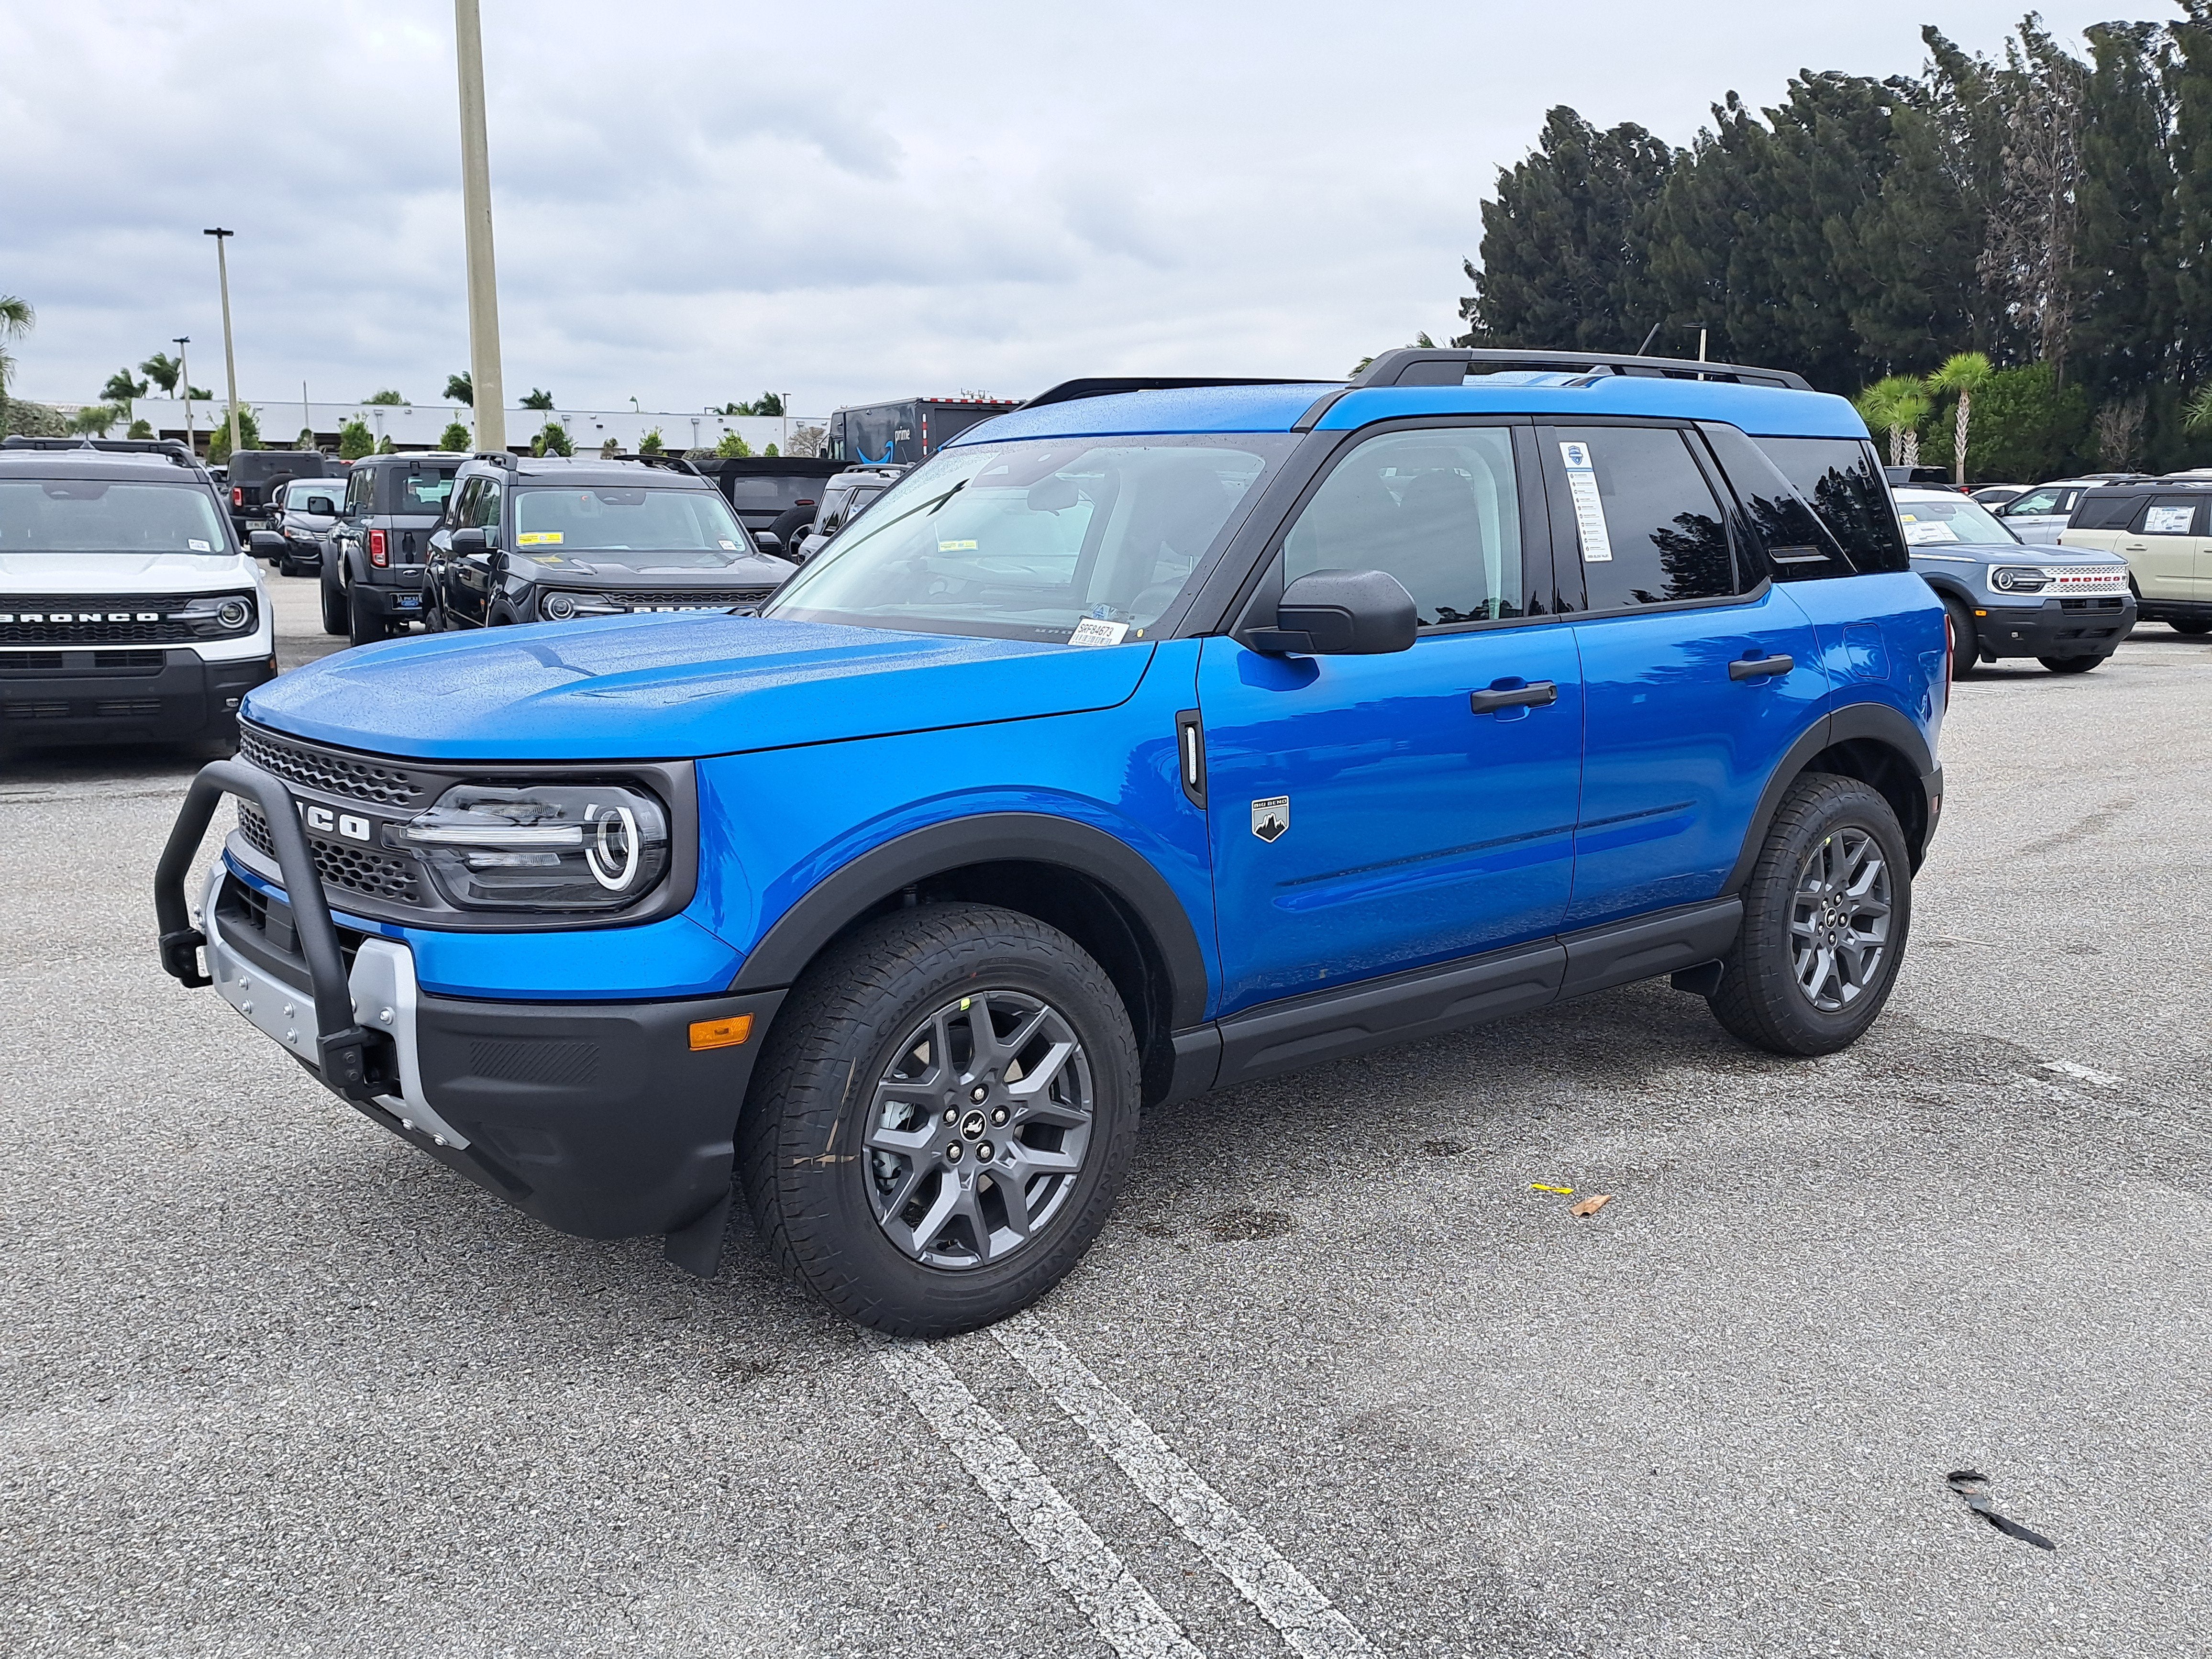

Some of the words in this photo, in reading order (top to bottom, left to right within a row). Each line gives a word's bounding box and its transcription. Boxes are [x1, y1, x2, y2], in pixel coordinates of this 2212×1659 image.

[895, 426, 910, 446] prime
[2060, 572, 2120, 582] BRONCO
[1078, 623, 1114, 637] SRF84673
